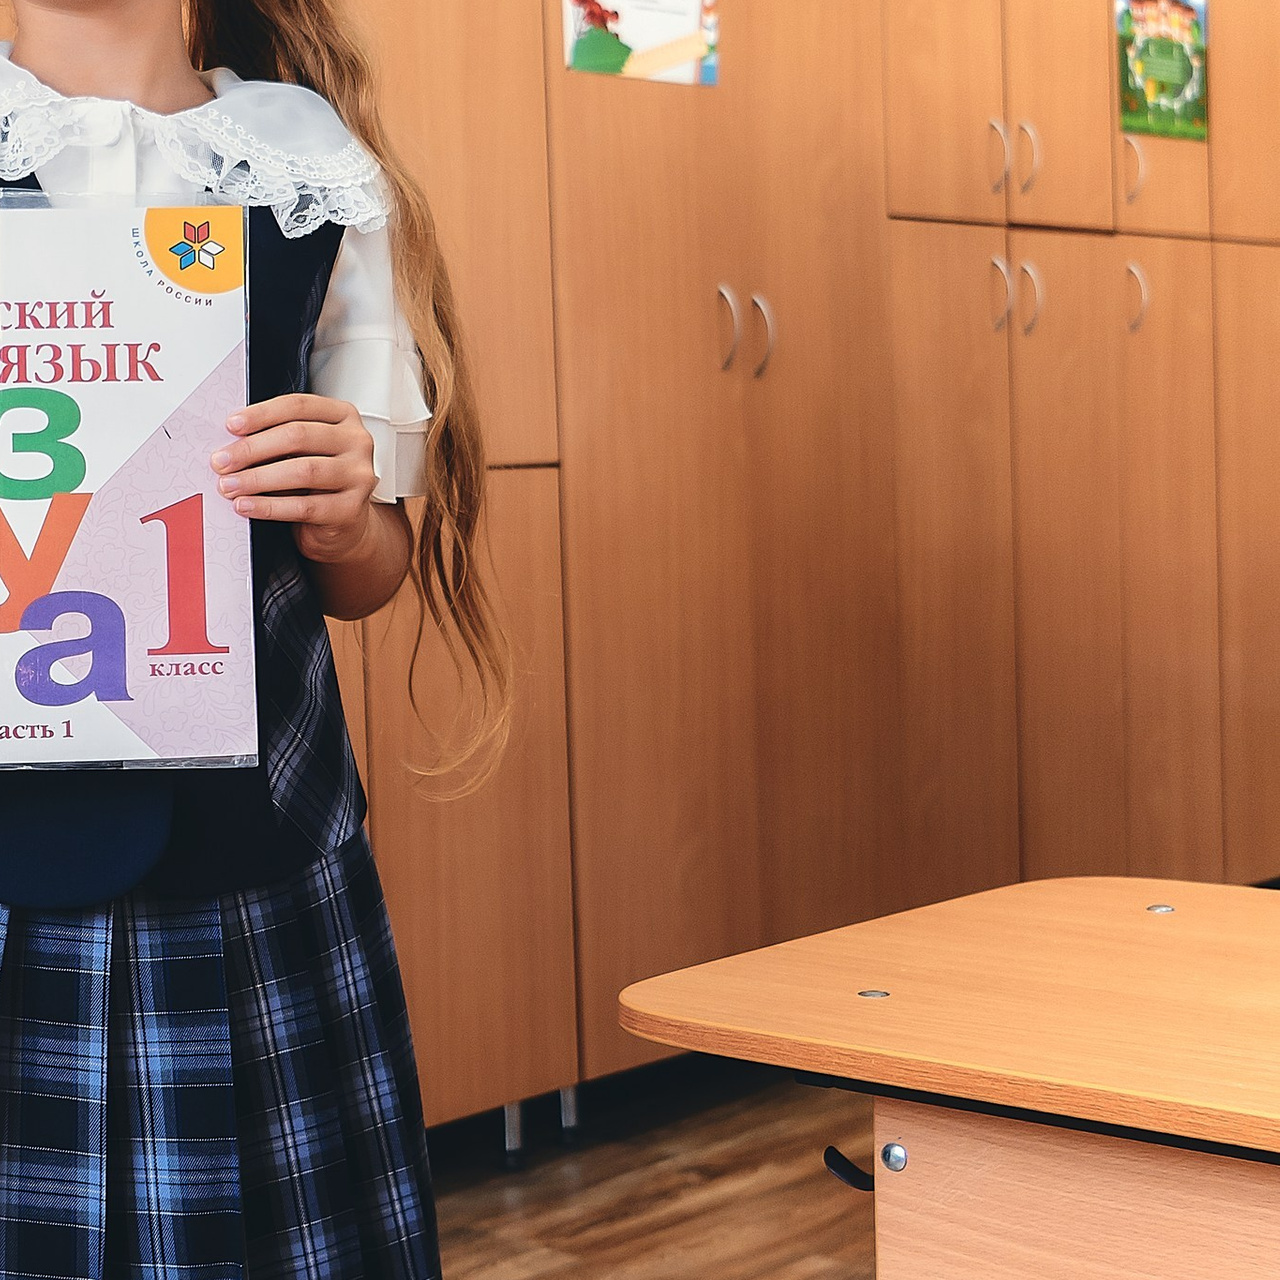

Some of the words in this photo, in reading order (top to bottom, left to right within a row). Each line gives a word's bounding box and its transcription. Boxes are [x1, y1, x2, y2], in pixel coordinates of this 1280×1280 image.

[131, 227, 154, 277] ШКОЛА
[157, 279, 212, 306] РОССИИ
[139, 492, 230, 656] 1
[148, 660, 225, 678] класс
[61, 719, 75, 739] 1
